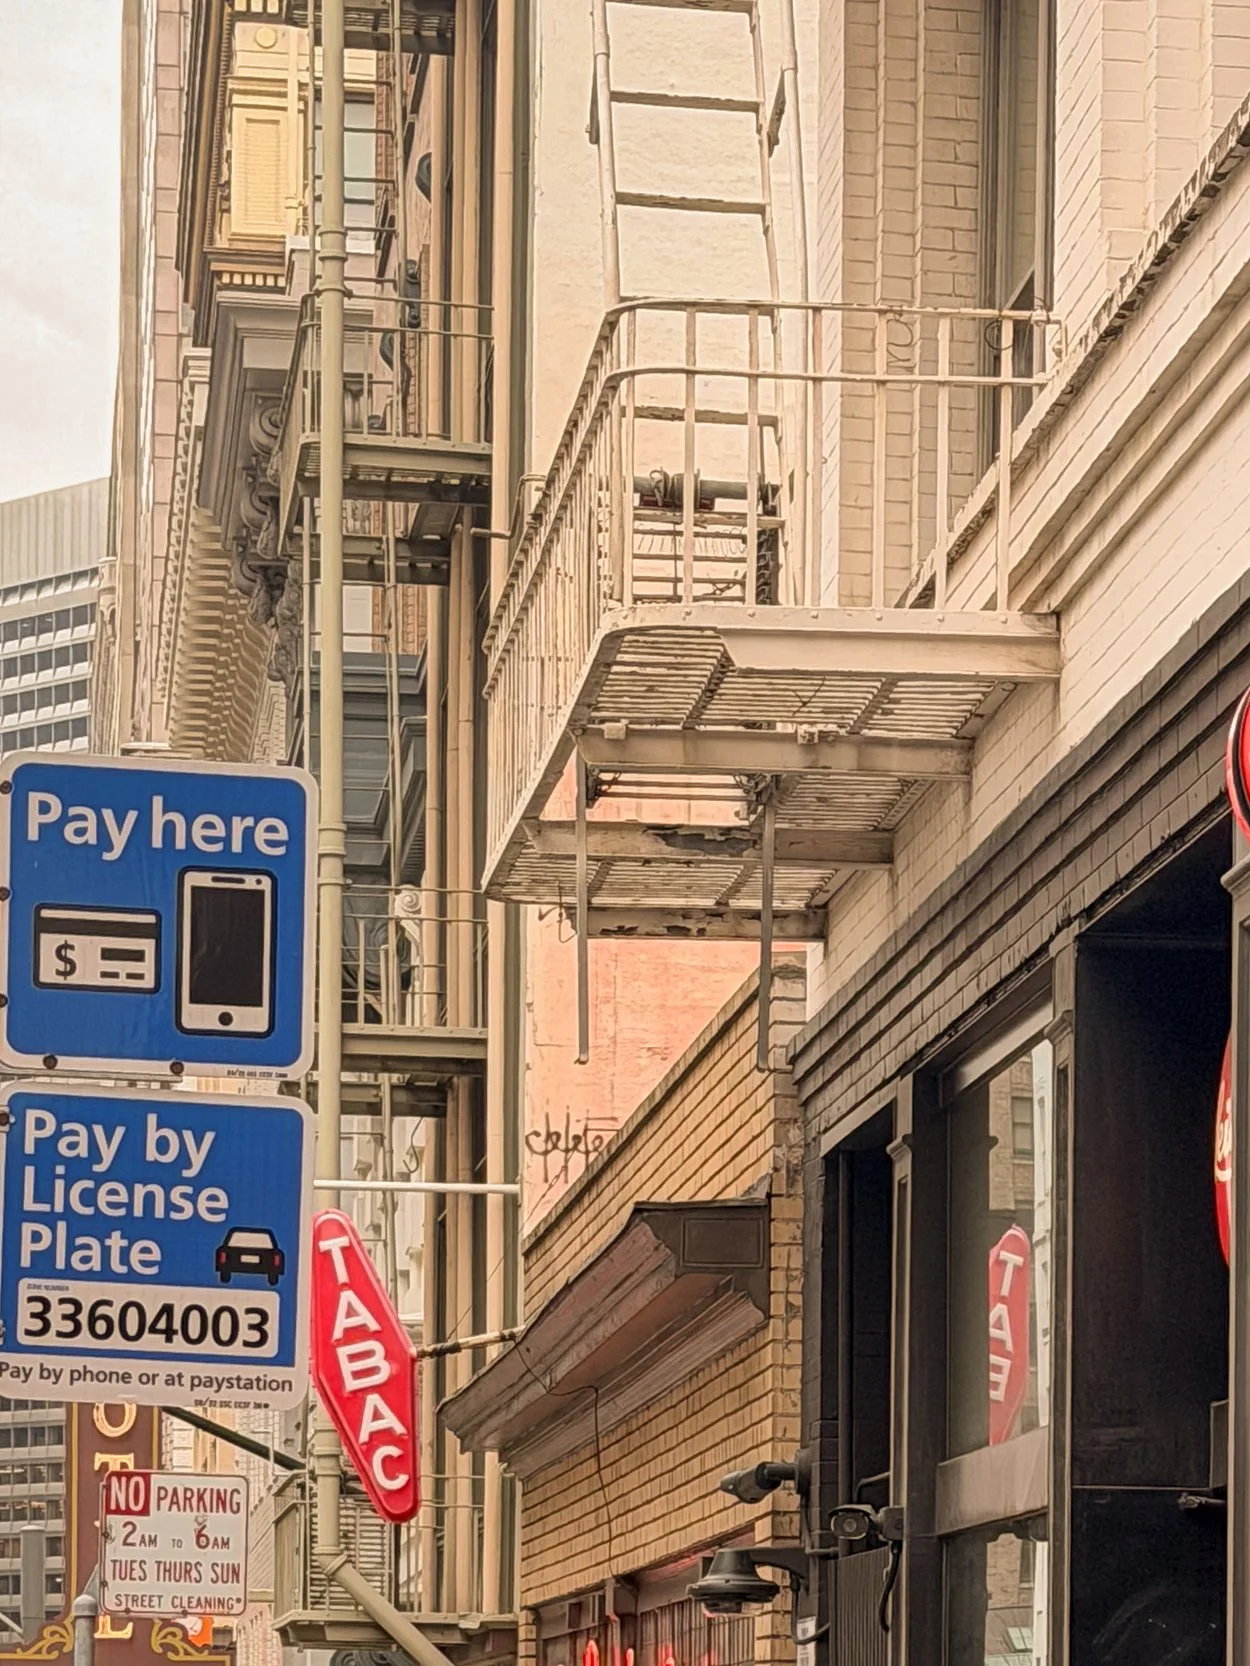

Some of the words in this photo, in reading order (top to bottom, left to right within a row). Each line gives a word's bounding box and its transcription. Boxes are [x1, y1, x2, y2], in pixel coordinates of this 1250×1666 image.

[26, 790, 139, 861] Pay
[151, 795, 289, 856] here
[24, 1108, 126, 1173] Pay
[145, 1112, 216, 1178] by
[22, 1165, 229, 1222] License
[20, 1220, 162, 1275] Plate
[23, 1295, 270, 1349] 33604003
[0, 1361, 33, 1384] Pay
[39, 1362, 63, 1385] by
[69, 1365, 132, 1386] phone
[139, 1369, 160, 1386] or
[164, 1370, 184, 1388] at
[190, 1371, 293, 1392] paystation
[318, 1236, 411, 1490] TABAC
[110, 1476, 146, 1511] NO
[156, 1486, 241, 1515] PARKING
[121, 1521, 158, 1548] 2AM
[171, 1537, 183, 1548] TO
[194, 1524, 230, 1550] 6AM
[110, 1559, 147, 1582] TUES
[155, 1560, 203, 1584] THURS
[210, 1562, 241, 1584] SUN
[115, 1593, 164, 1609] STREET
[171, 1595, 235, 1610] CLEANING
